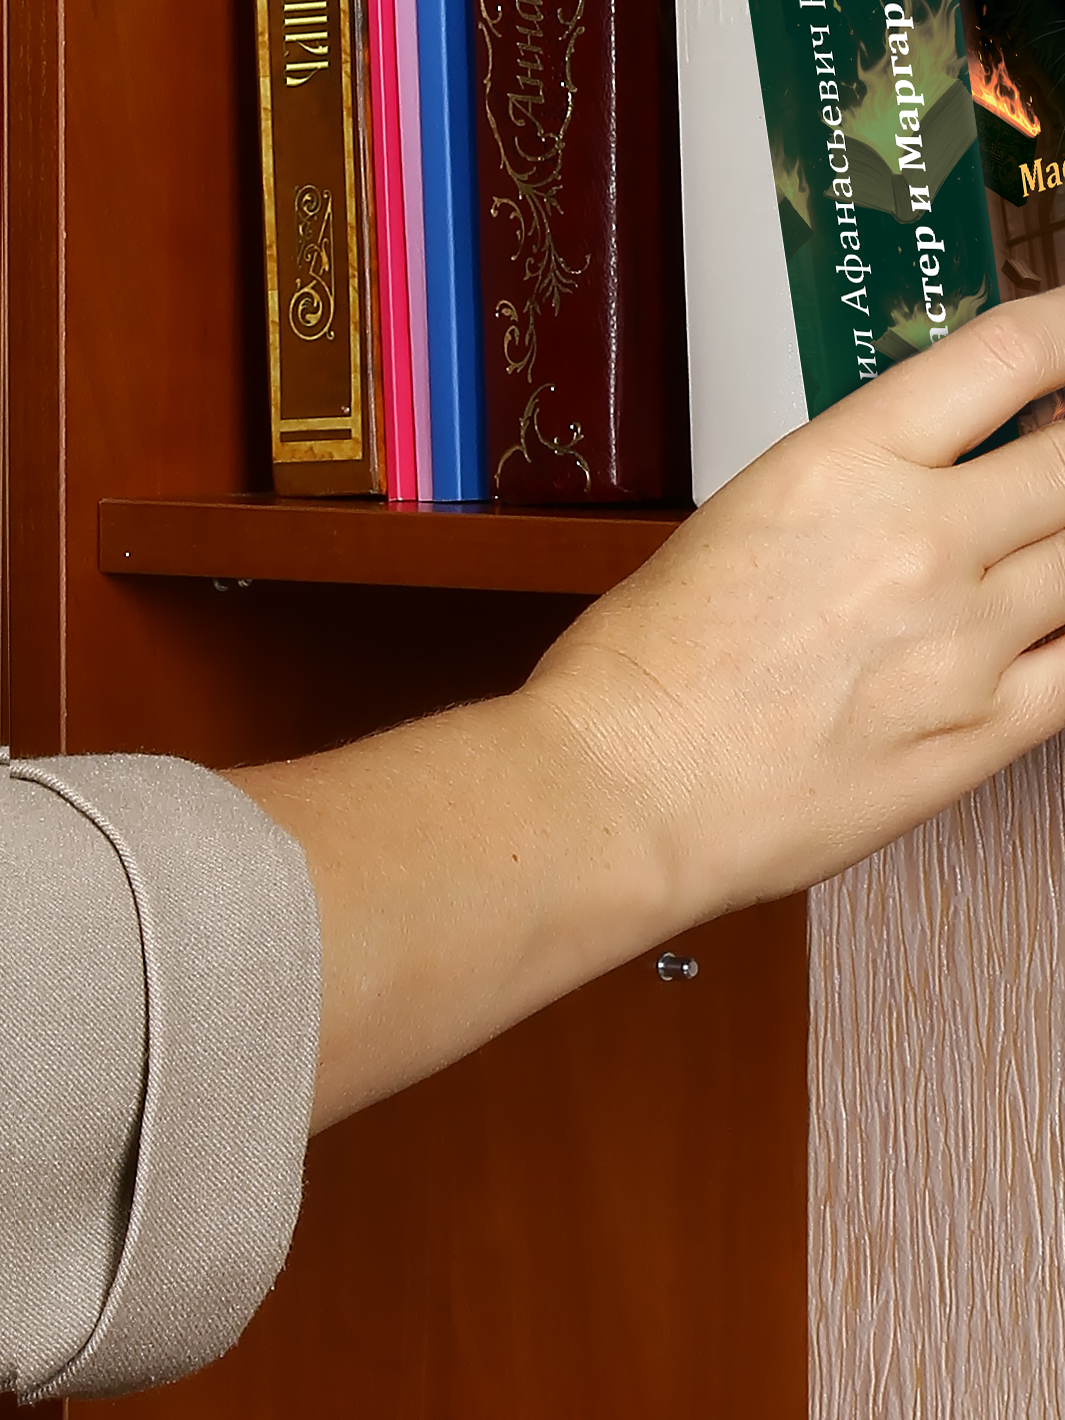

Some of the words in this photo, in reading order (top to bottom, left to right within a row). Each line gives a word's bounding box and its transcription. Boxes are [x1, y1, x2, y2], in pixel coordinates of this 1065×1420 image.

[810, 24, 872, 317] Афанасьевич
[909, 184, 933, 213] и
[915, 225, 949, 345] астер
